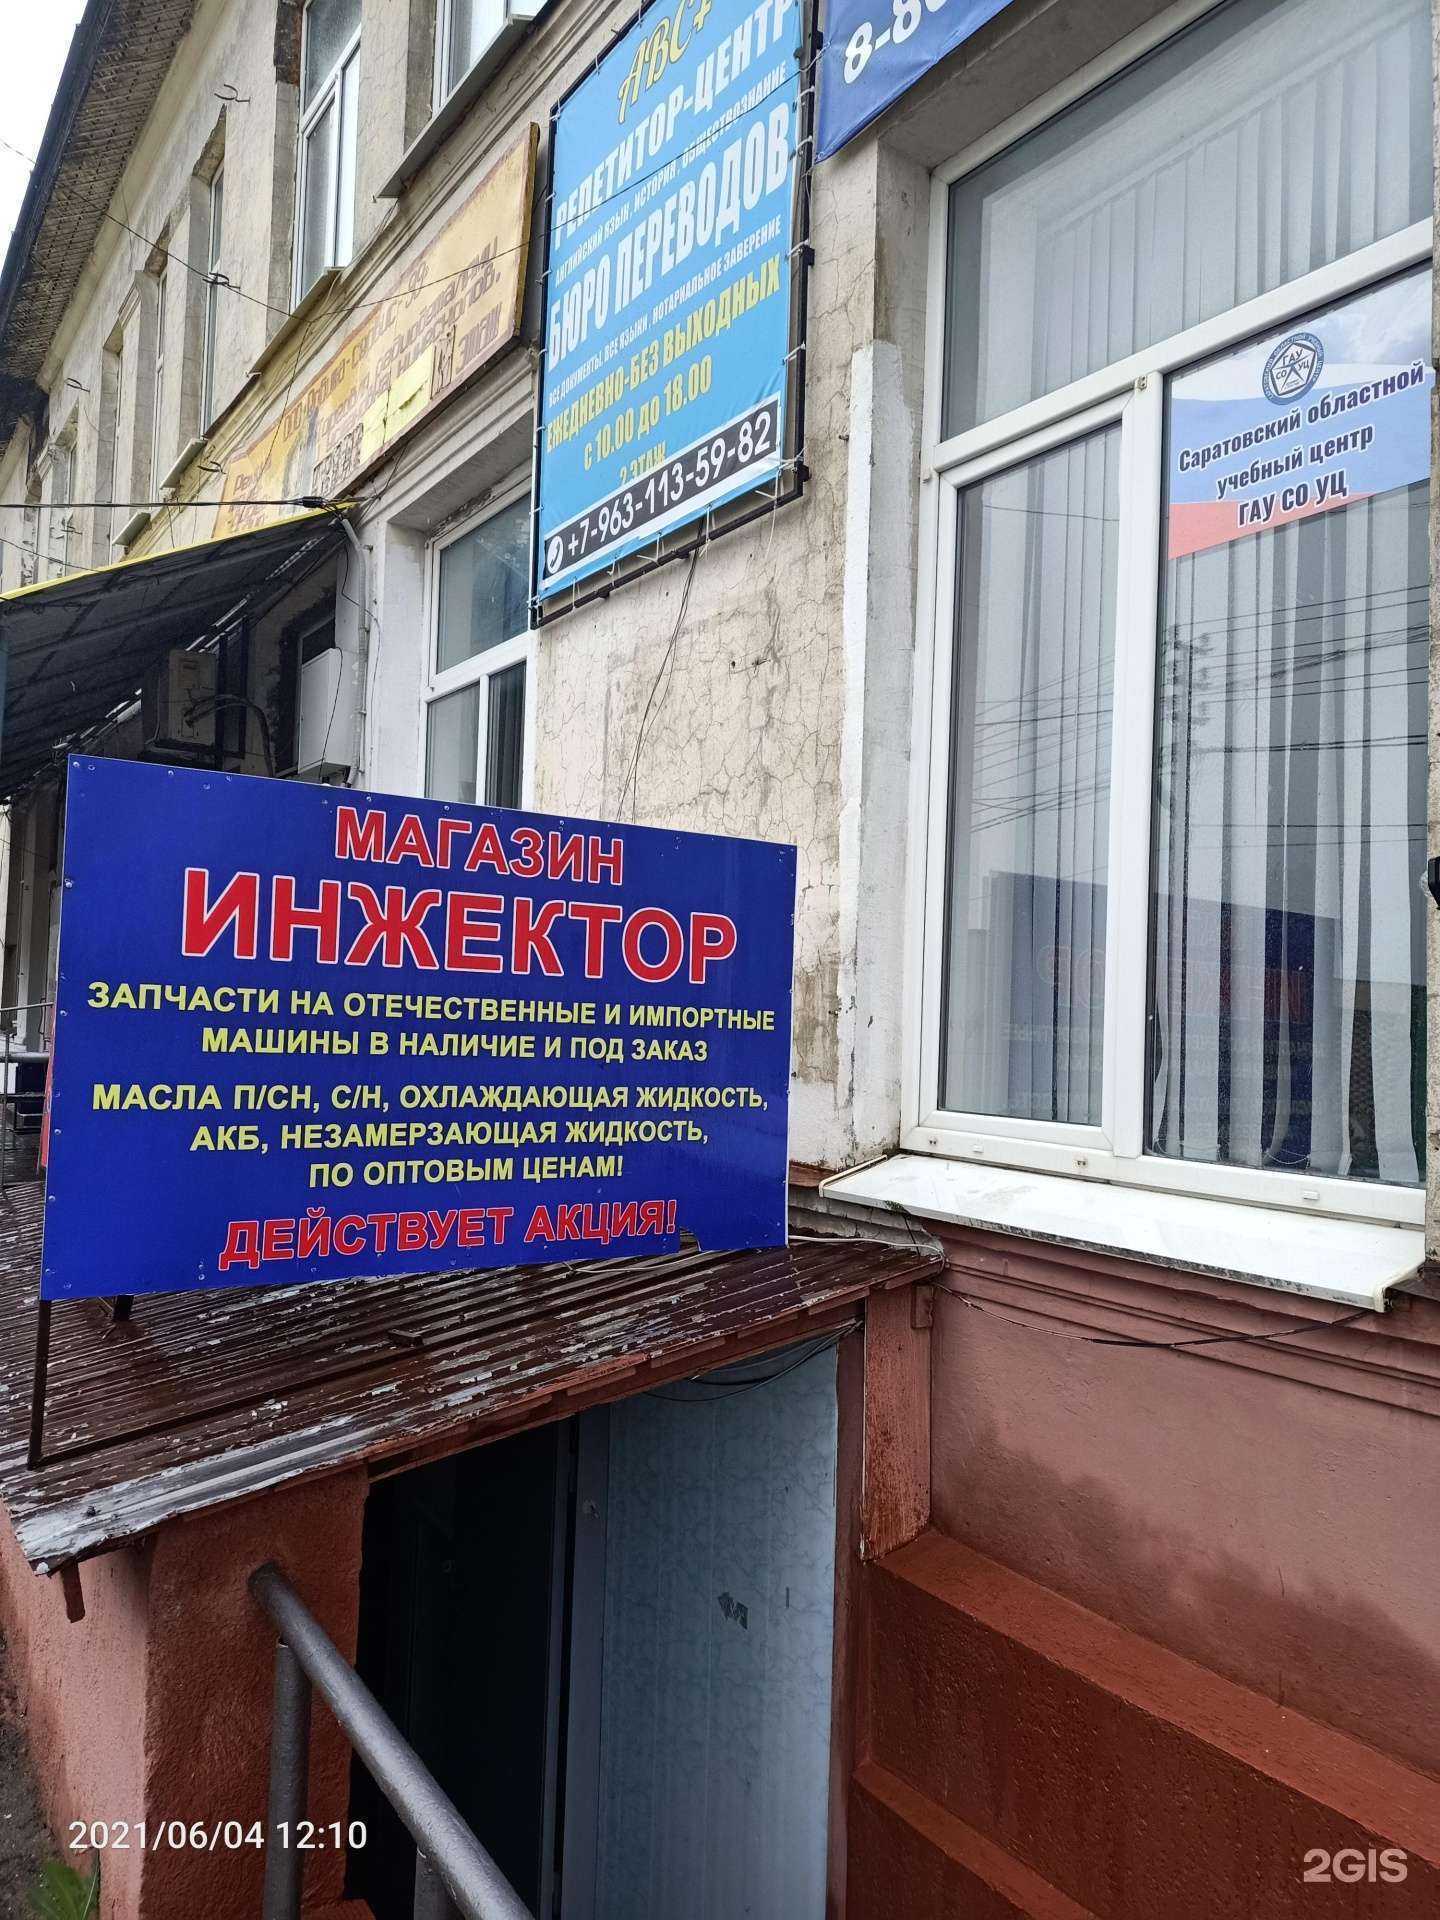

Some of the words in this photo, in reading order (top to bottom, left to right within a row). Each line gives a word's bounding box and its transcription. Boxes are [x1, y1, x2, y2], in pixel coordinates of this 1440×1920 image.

[843, 0, 946, 84] 8-8
[548, 254, 611, 372] БЮРО
[614, 102, 790, 315] ПЕРЕВОДОВ
[652, 257, 722, 325] НОТАРИАЛЬНОЕ
[723, 214, 782, 272] ЗАВЕРЕНИЕ
[663, 253, 781, 369] ВЫХОДНЫХ
[595, 411, 634, 461] 10.00
[663, 354, 713, 416] 18.00
[1178, 409, 1302, 472] Саратовский
[1307, 360, 1425, 424] областной
[567, 411, 772, 556] +7-963-113-59-82
[1217, 448, 1303, 499] учебный
[1310, 425, 1373, 465] центр
[1238, 494, 1276, 526] ГАУ
[1282, 483, 1309, 511] СО
[1316, 470, 1348, 505] УЦ
[334, 806, 625, 887] МАГАЗИН
[181, 866, 738, 985] ИНЖЕКТОР
[87, 981, 280, 1014] ЗАПЧАСТИ
[290, 990, 335, 1016] НА
[343, 992, 596, 1026] ОТЕЧЕСТВЕННЫЕ
[604, 1003, 621, 1026] И
[629, 1004, 776, 1031] ИМПОРТНЫЕ
[201, 1027, 360, 1056] МАШИНЫ
[369, 1032, 389, 1056] В
[400, 1032, 535, 1059] НАЛИЧИЕ
[544, 1038, 563, 1059] И
[570, 1037, 625, 1064] ПОД
[631, 1038, 709, 1063] ЗАКАЗ
[92, 1084, 223, 1111] МАСЛА
[233, 1084, 320, 1114] П/СН,
[330, 1084, 390, 1113] С/Н,
[399, 1085, 628, 1113] ОХЛАЖДАЮЩАЯ
[636, 1086, 769, 1113] ЖИДКОСТЬ,
[189, 1125, 268, 1155] АКБ,
[280, 1121, 557, 1150] НЕЗАМЕРЗАЮЩАЯ
[565, 1119, 709, 1147] ЖИДКОСТЬ,
[308, 1162, 353, 1189] ПО
[363, 1157, 514, 1187] ОПТОВЫМ
[522, 1156, 624, 1184] ЦЕНАМ!
[217, 1206, 515, 1271] ДЕЙСТВУЕТ
[523, 1199, 678, 1246] АКЦИЯ!
